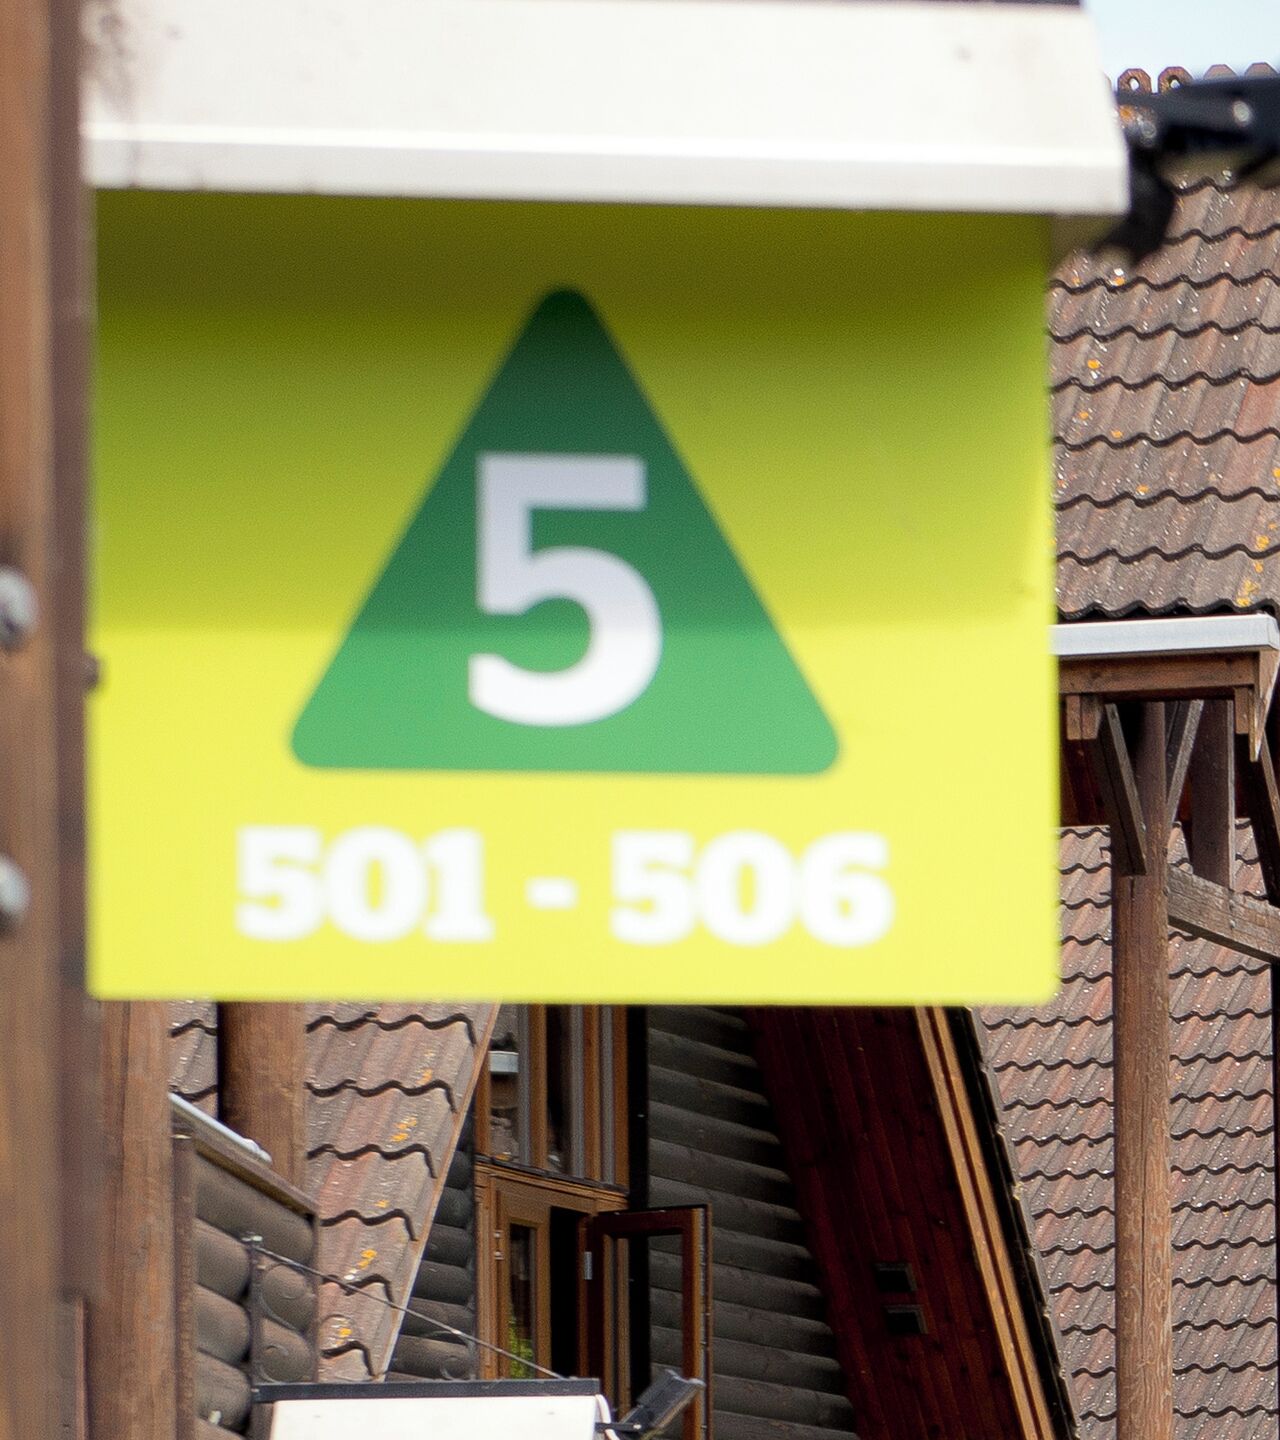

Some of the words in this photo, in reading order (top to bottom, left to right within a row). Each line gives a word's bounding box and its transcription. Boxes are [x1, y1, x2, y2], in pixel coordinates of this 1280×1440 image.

[467, 452, 664, 728] 5
[235, 825, 495, 942] 501
[529, 877, 575, 910] -
[610, 830, 894, 946] 506
